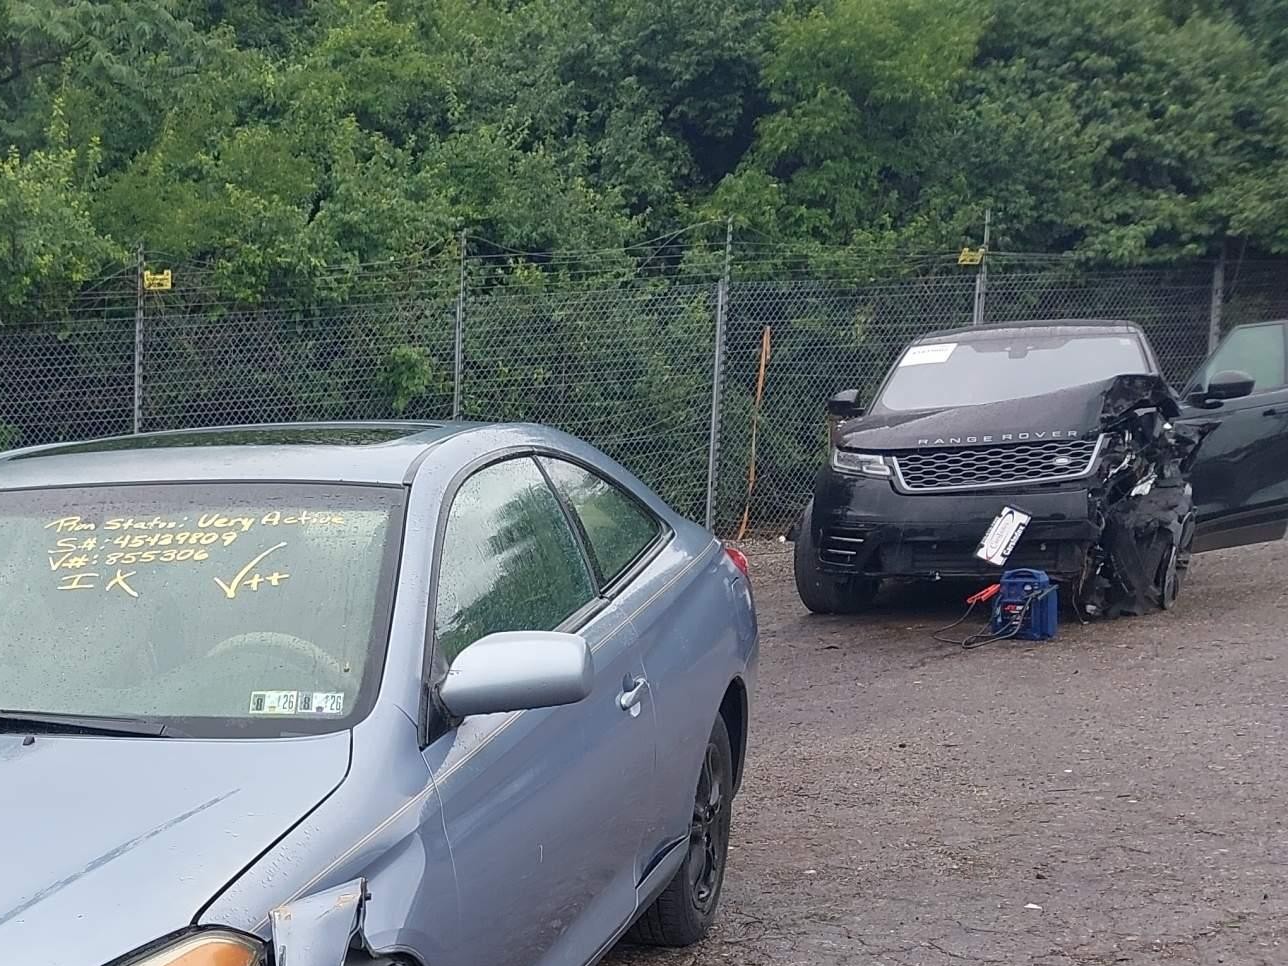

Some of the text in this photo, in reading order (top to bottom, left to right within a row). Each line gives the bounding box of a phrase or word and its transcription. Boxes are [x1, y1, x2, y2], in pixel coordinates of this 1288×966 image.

[918, 430, 1078, 445] RANGE ROVER
[198, 513, 255, 531] Very
[261, 511, 345, 526] Active
[105, 549, 209, 565] 855306
